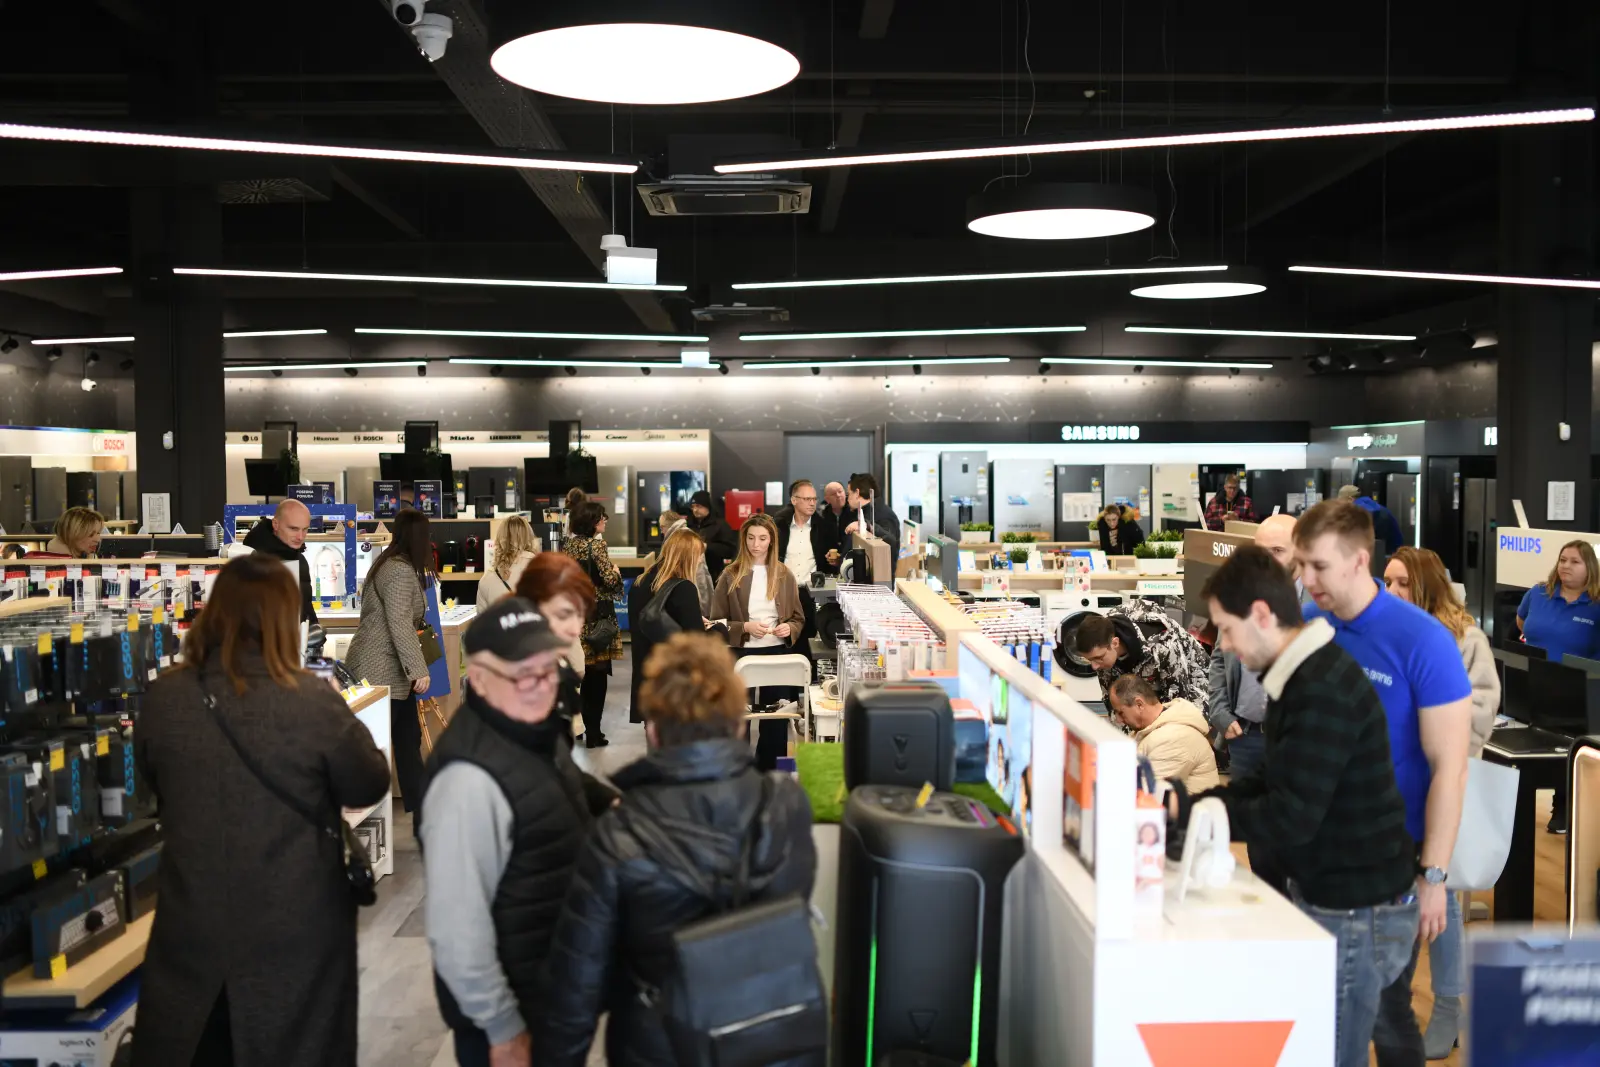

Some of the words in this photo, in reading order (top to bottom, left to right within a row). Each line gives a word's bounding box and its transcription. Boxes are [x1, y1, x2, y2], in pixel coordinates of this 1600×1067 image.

[1061, 425, 1140, 441] SAMSUNG
[103, 438, 125, 450] BOSCH
[1500, 535, 1542, 554] PHILIPS
[120, 631, 133, 679] G502
